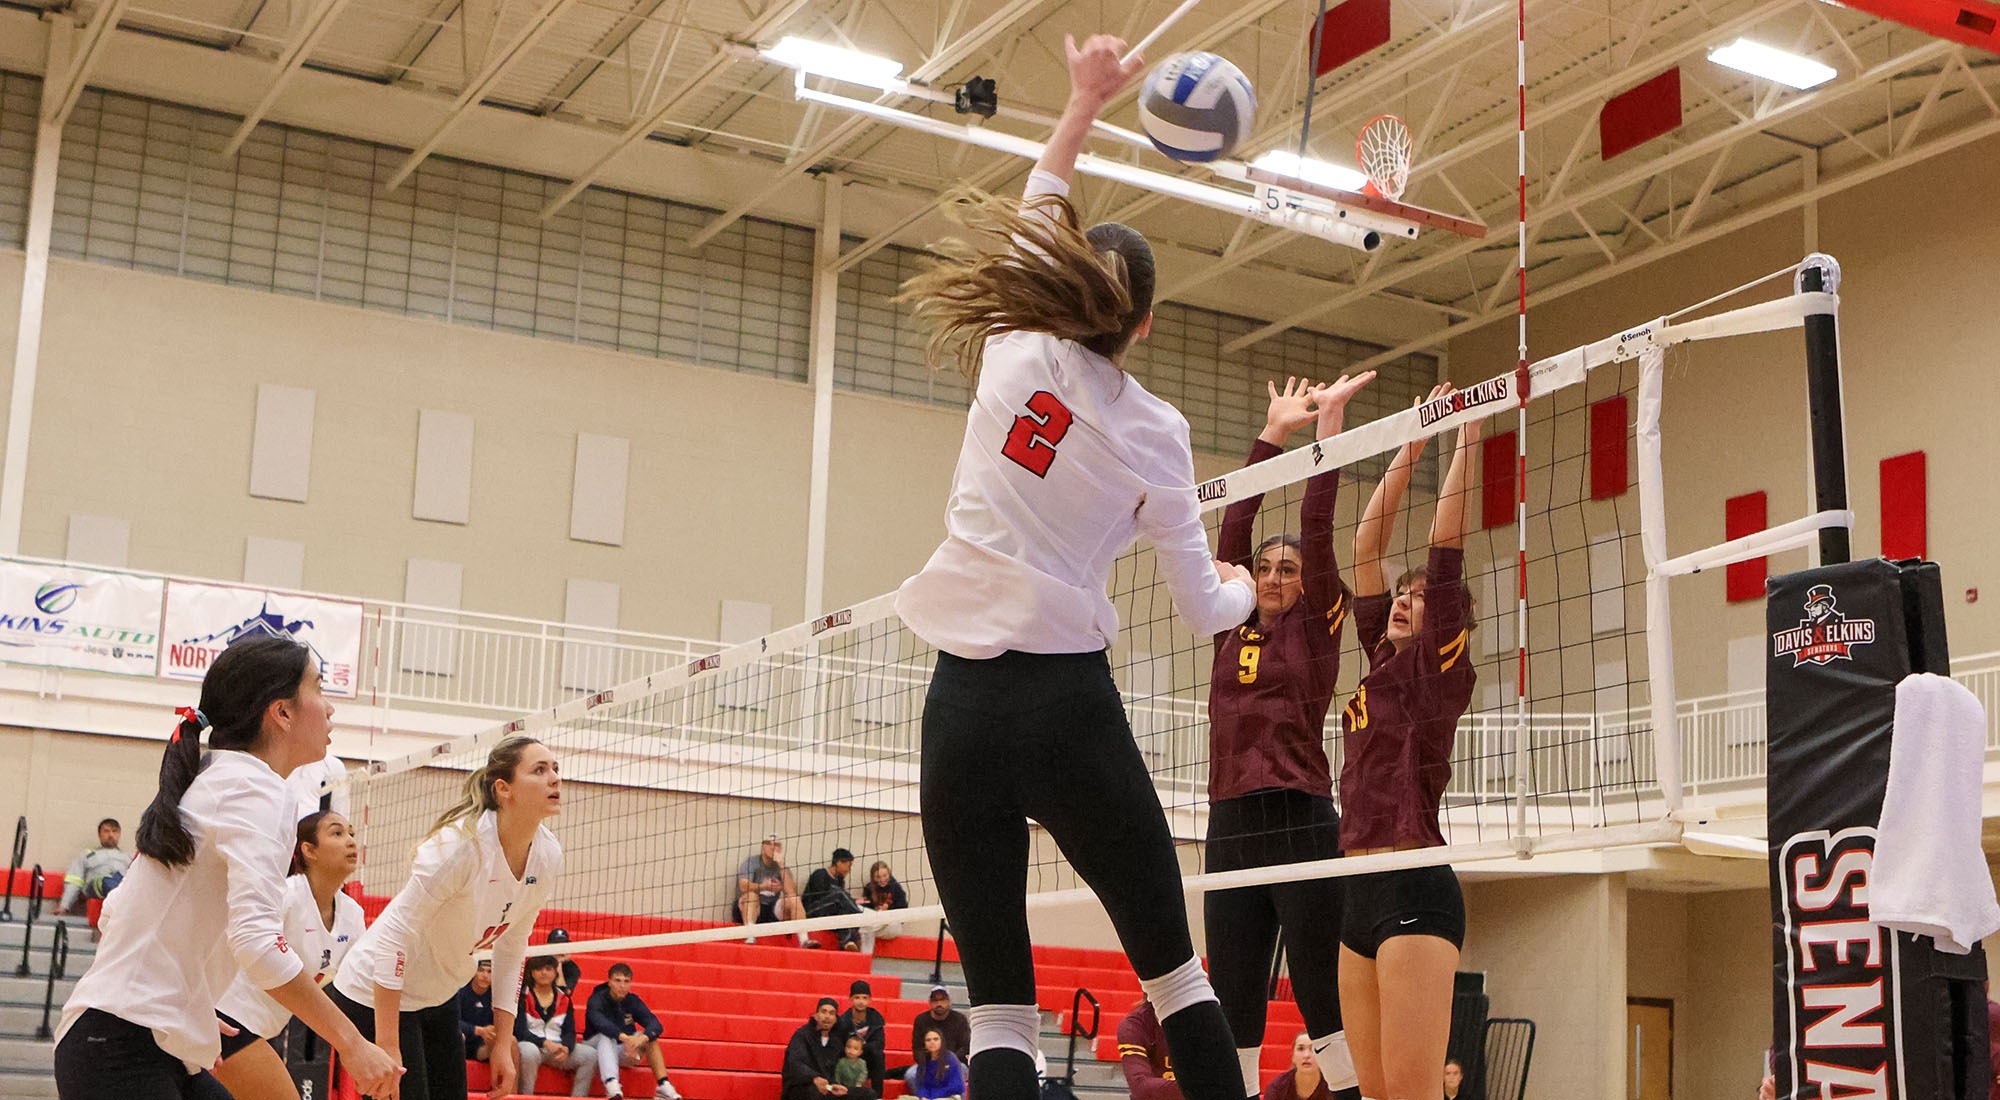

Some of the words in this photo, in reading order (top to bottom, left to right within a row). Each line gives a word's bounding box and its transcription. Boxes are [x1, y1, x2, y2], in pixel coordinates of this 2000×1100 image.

[1265, 187, 1280, 210] 5
[1627, 328, 1652, 341] Senoh
[1001, 390, 1073, 479] 2
[68, 626, 155, 644] AUTO
[169, 643, 223, 669] NORT
[1238, 644, 1261, 684] 9
